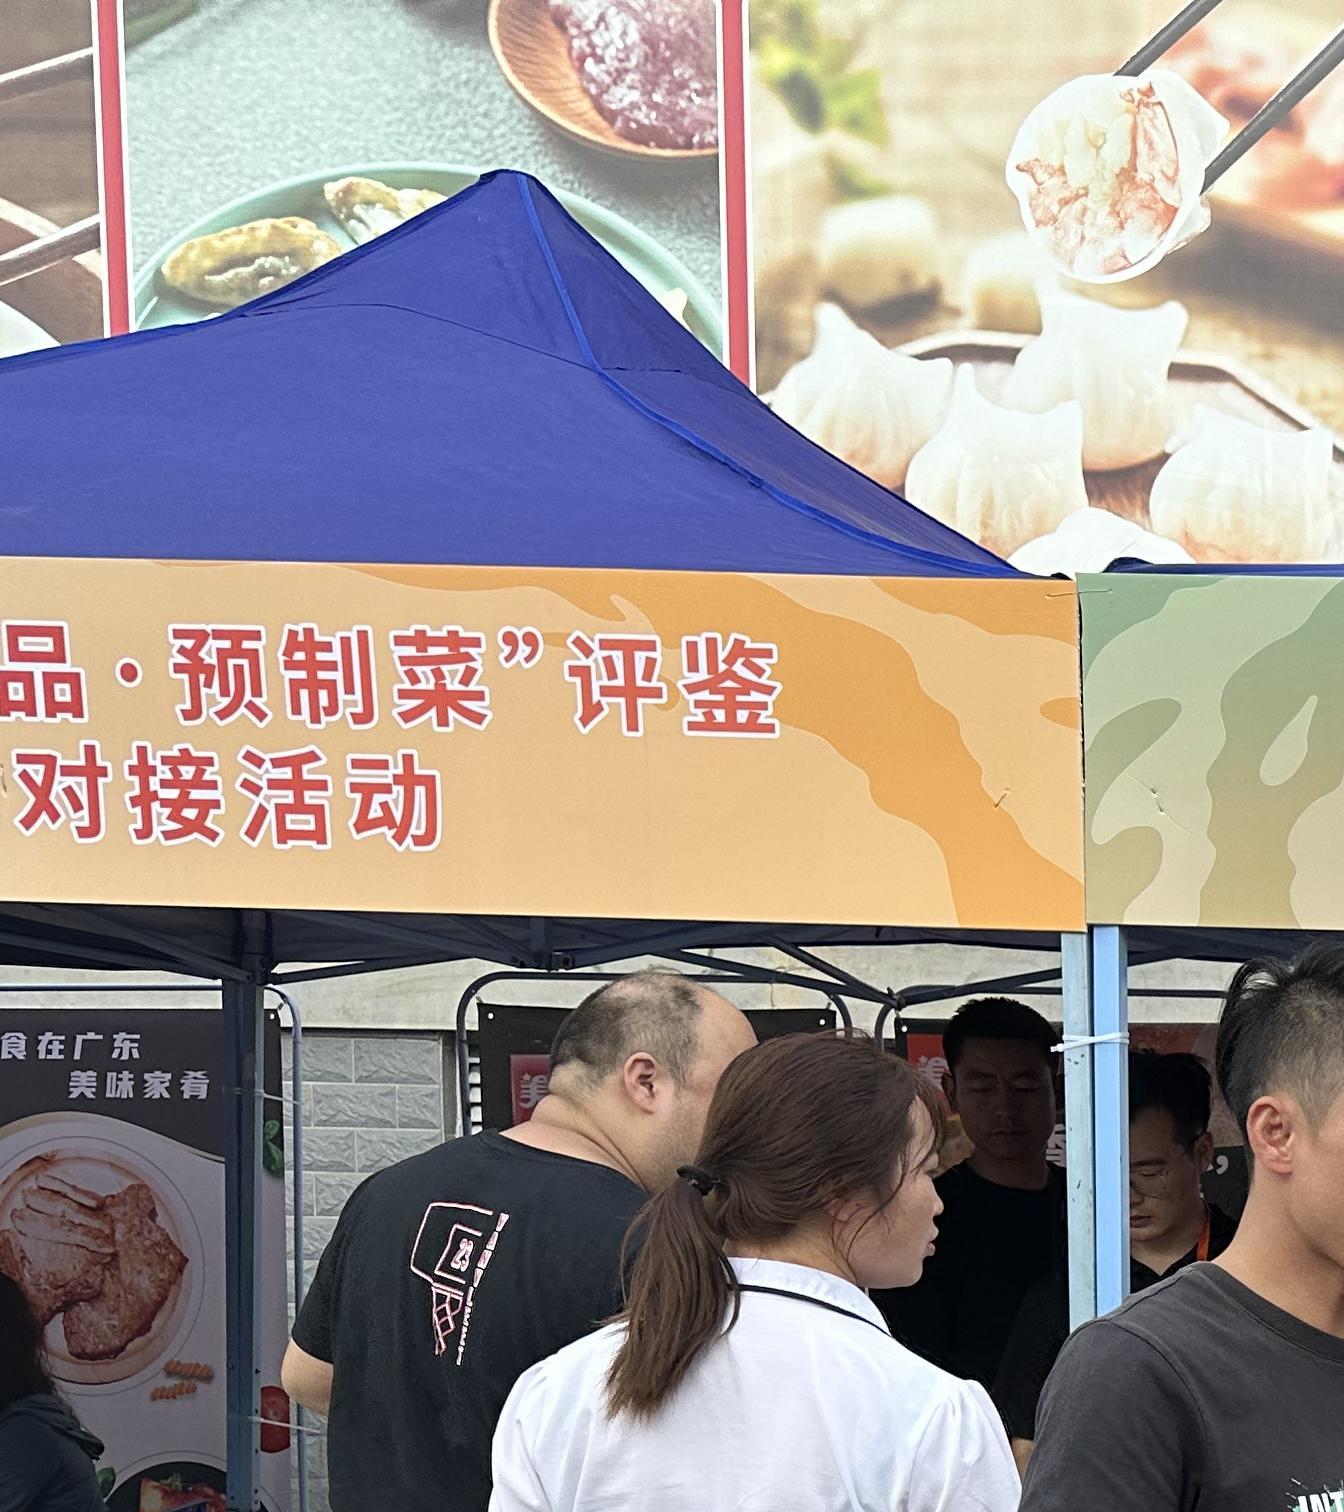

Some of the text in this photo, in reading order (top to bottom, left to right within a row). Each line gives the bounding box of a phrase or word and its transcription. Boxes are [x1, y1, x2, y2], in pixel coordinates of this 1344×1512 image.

[12, 743, 444, 852] 对接活动
[0, 1032, 142, 1061] 食在广东
[68, 1070, 210, 1101] 美味家肴
